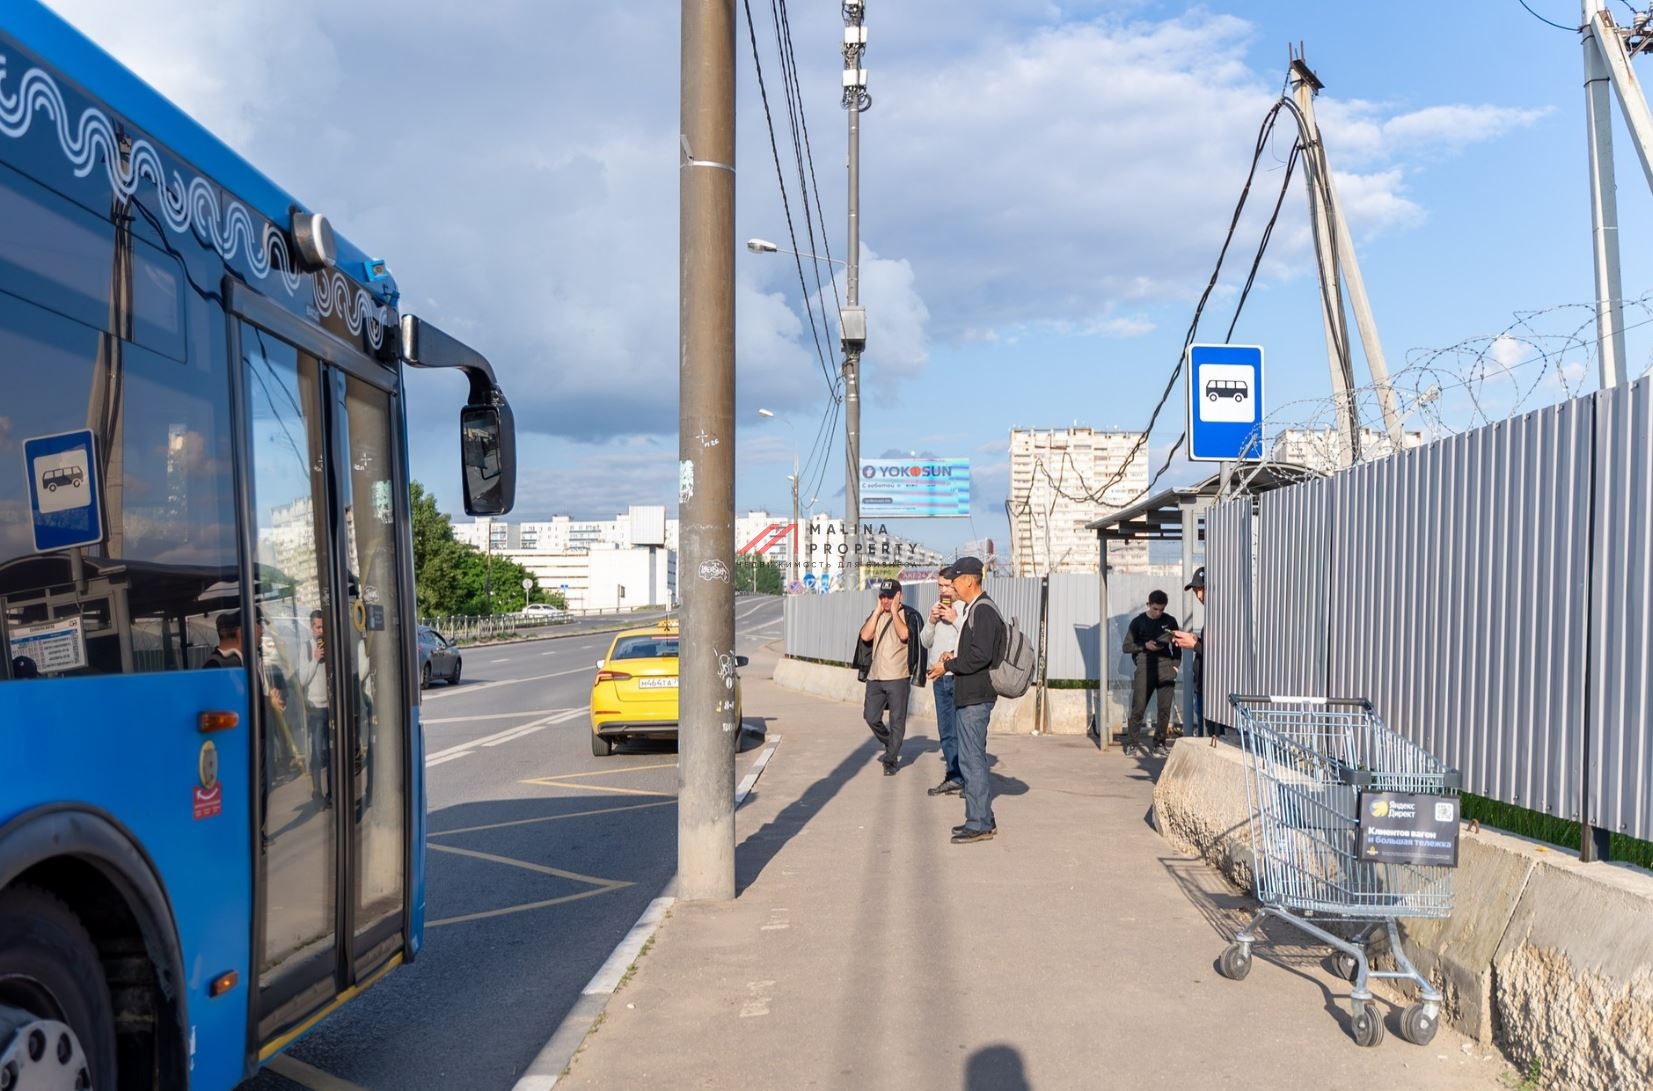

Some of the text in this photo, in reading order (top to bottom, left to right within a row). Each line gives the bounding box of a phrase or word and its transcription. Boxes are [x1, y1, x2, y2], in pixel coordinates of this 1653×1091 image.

[880, 466, 952, 477] YOKOSUN
[1389, 801, 1416, 810] Яндекс
[1388, 810, 1416, 819] Директ
[1368, 826, 1437, 840] Клиентов вагон
[1375, 836, 1413, 846] большая
[1415, 840, 1452, 849] тележка
